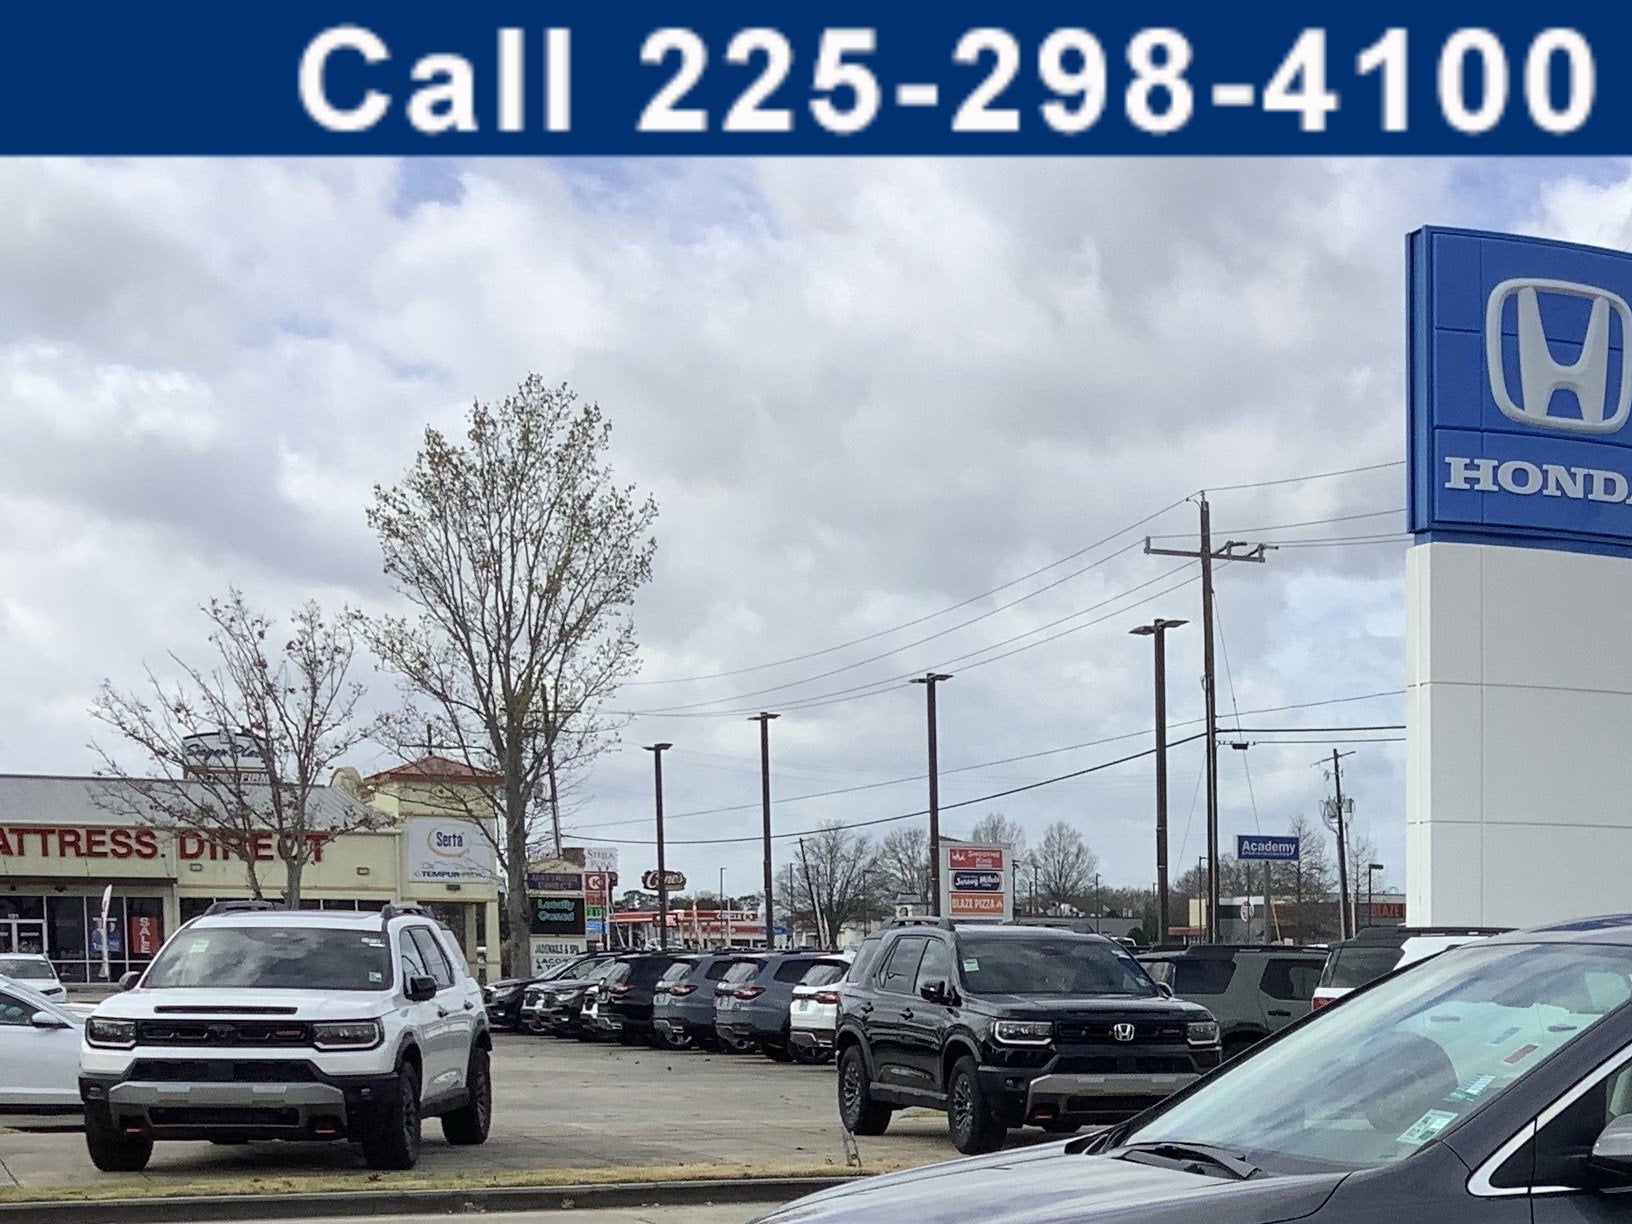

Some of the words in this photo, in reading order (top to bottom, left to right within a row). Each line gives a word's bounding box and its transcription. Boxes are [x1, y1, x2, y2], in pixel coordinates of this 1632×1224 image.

[436, 831, 463, 847] Serta
[1242, 839, 1296, 855] Academy
[140, 917, 150, 954] SALE
